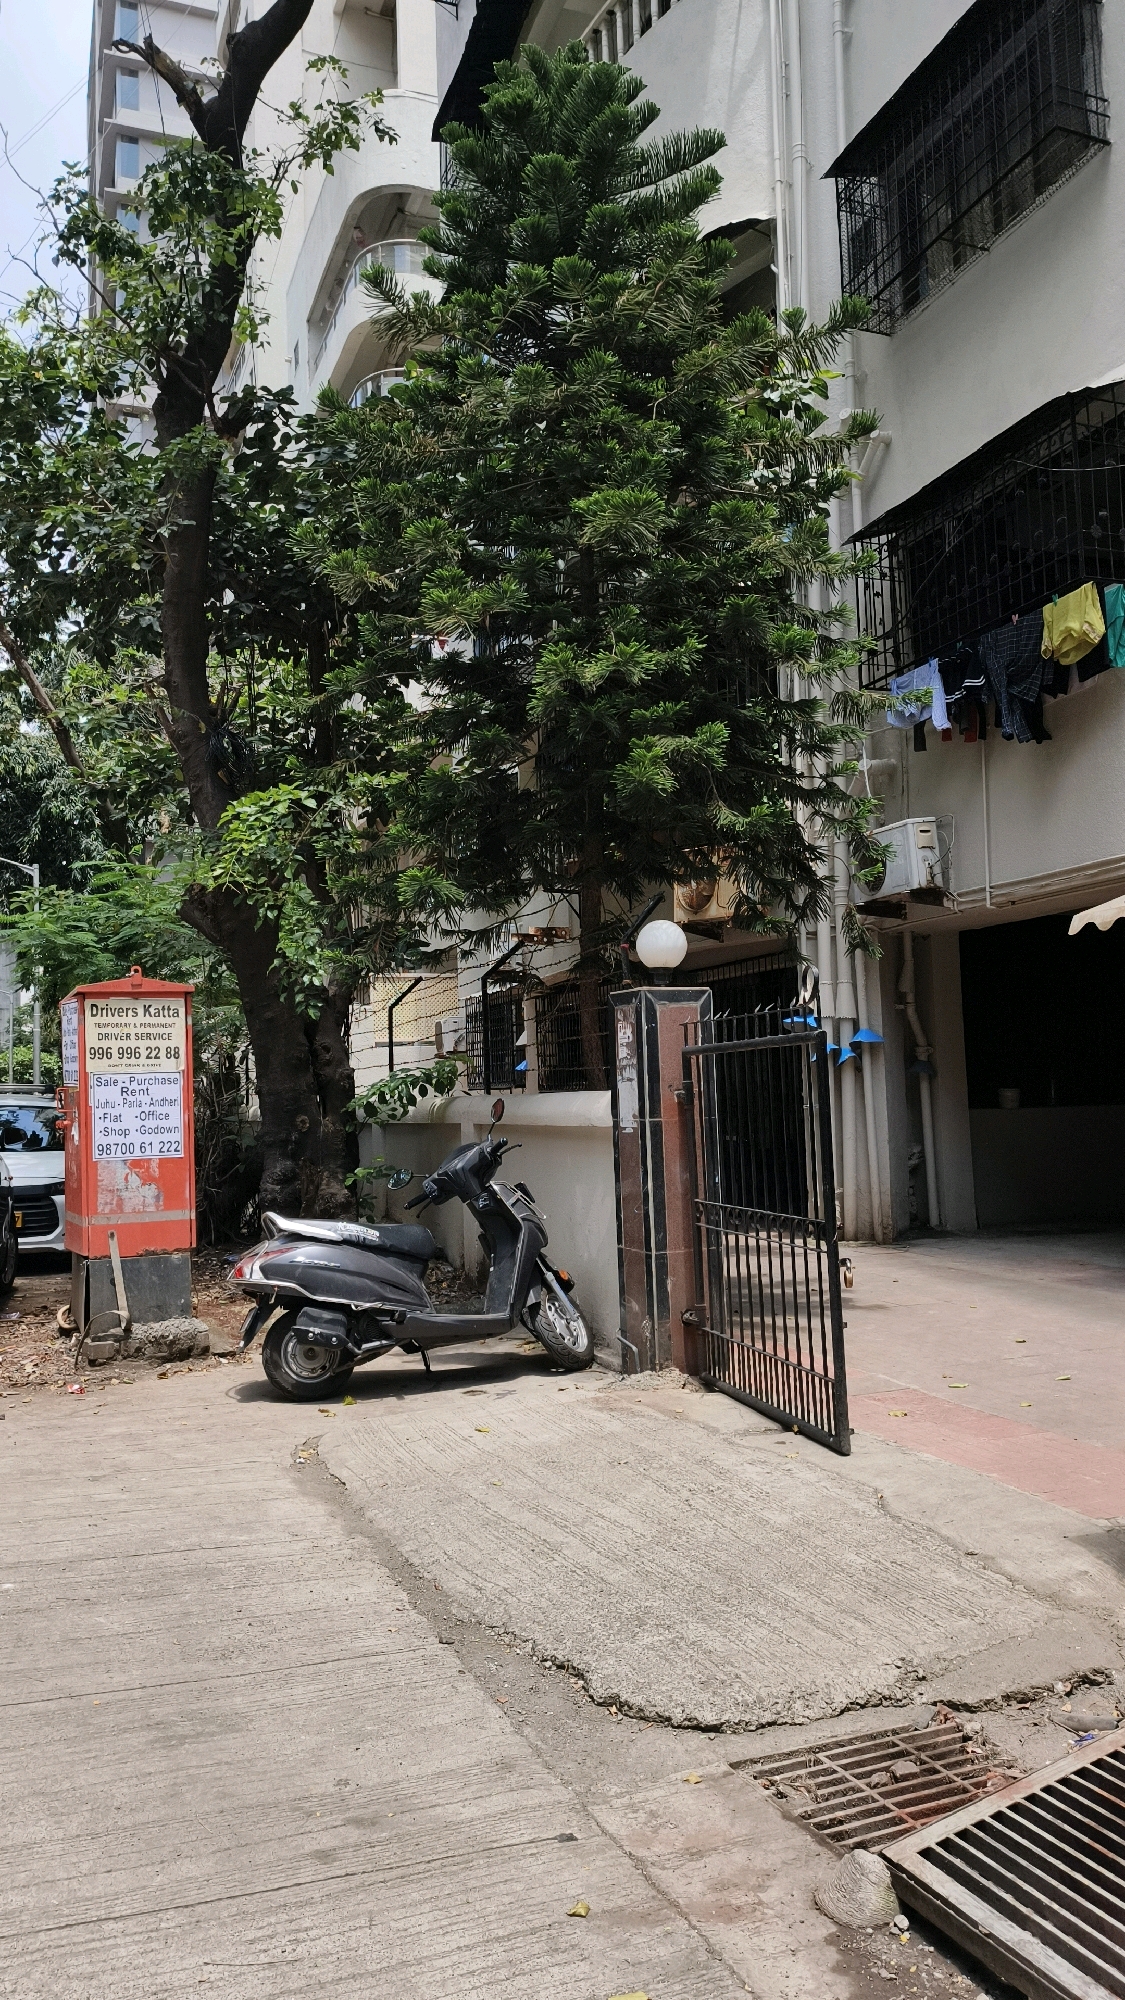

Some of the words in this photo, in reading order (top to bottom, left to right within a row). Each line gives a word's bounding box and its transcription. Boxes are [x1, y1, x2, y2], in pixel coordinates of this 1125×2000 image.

[90, 1004, 138, 1018] Drivers
[143, 1004, 180, 1018] Katta
[97, 1033, 131, 1041] DRIVER
[134, 1033, 173, 1041] SERVICE
[89, 1046, 112, 1060] 996
[117, 1046, 141, 1060] 996
[145, 1046, 161, 1060] 22
[165, 1046, 180, 1060] 88
[95, 1077, 119, 1087] Sale
[129, 1076, 179, 1086] Purchase
[121, 1086, 150, 1096] Rent
[95, 1099, 116, 1109] Juhu
[148, 1096, 179, 1107] Andheri
[103, 1112, 123, 1123] Flat
[139, 1110, 170, 1121] Office
[103, 1126, 131, 1139] Shop
[139, 1124, 180, 1135] Godown
[97, 1142, 135, 1156] 98700
[140, 1141, 153, 1154] 61
[158, 1140, 181, 1154] 222
